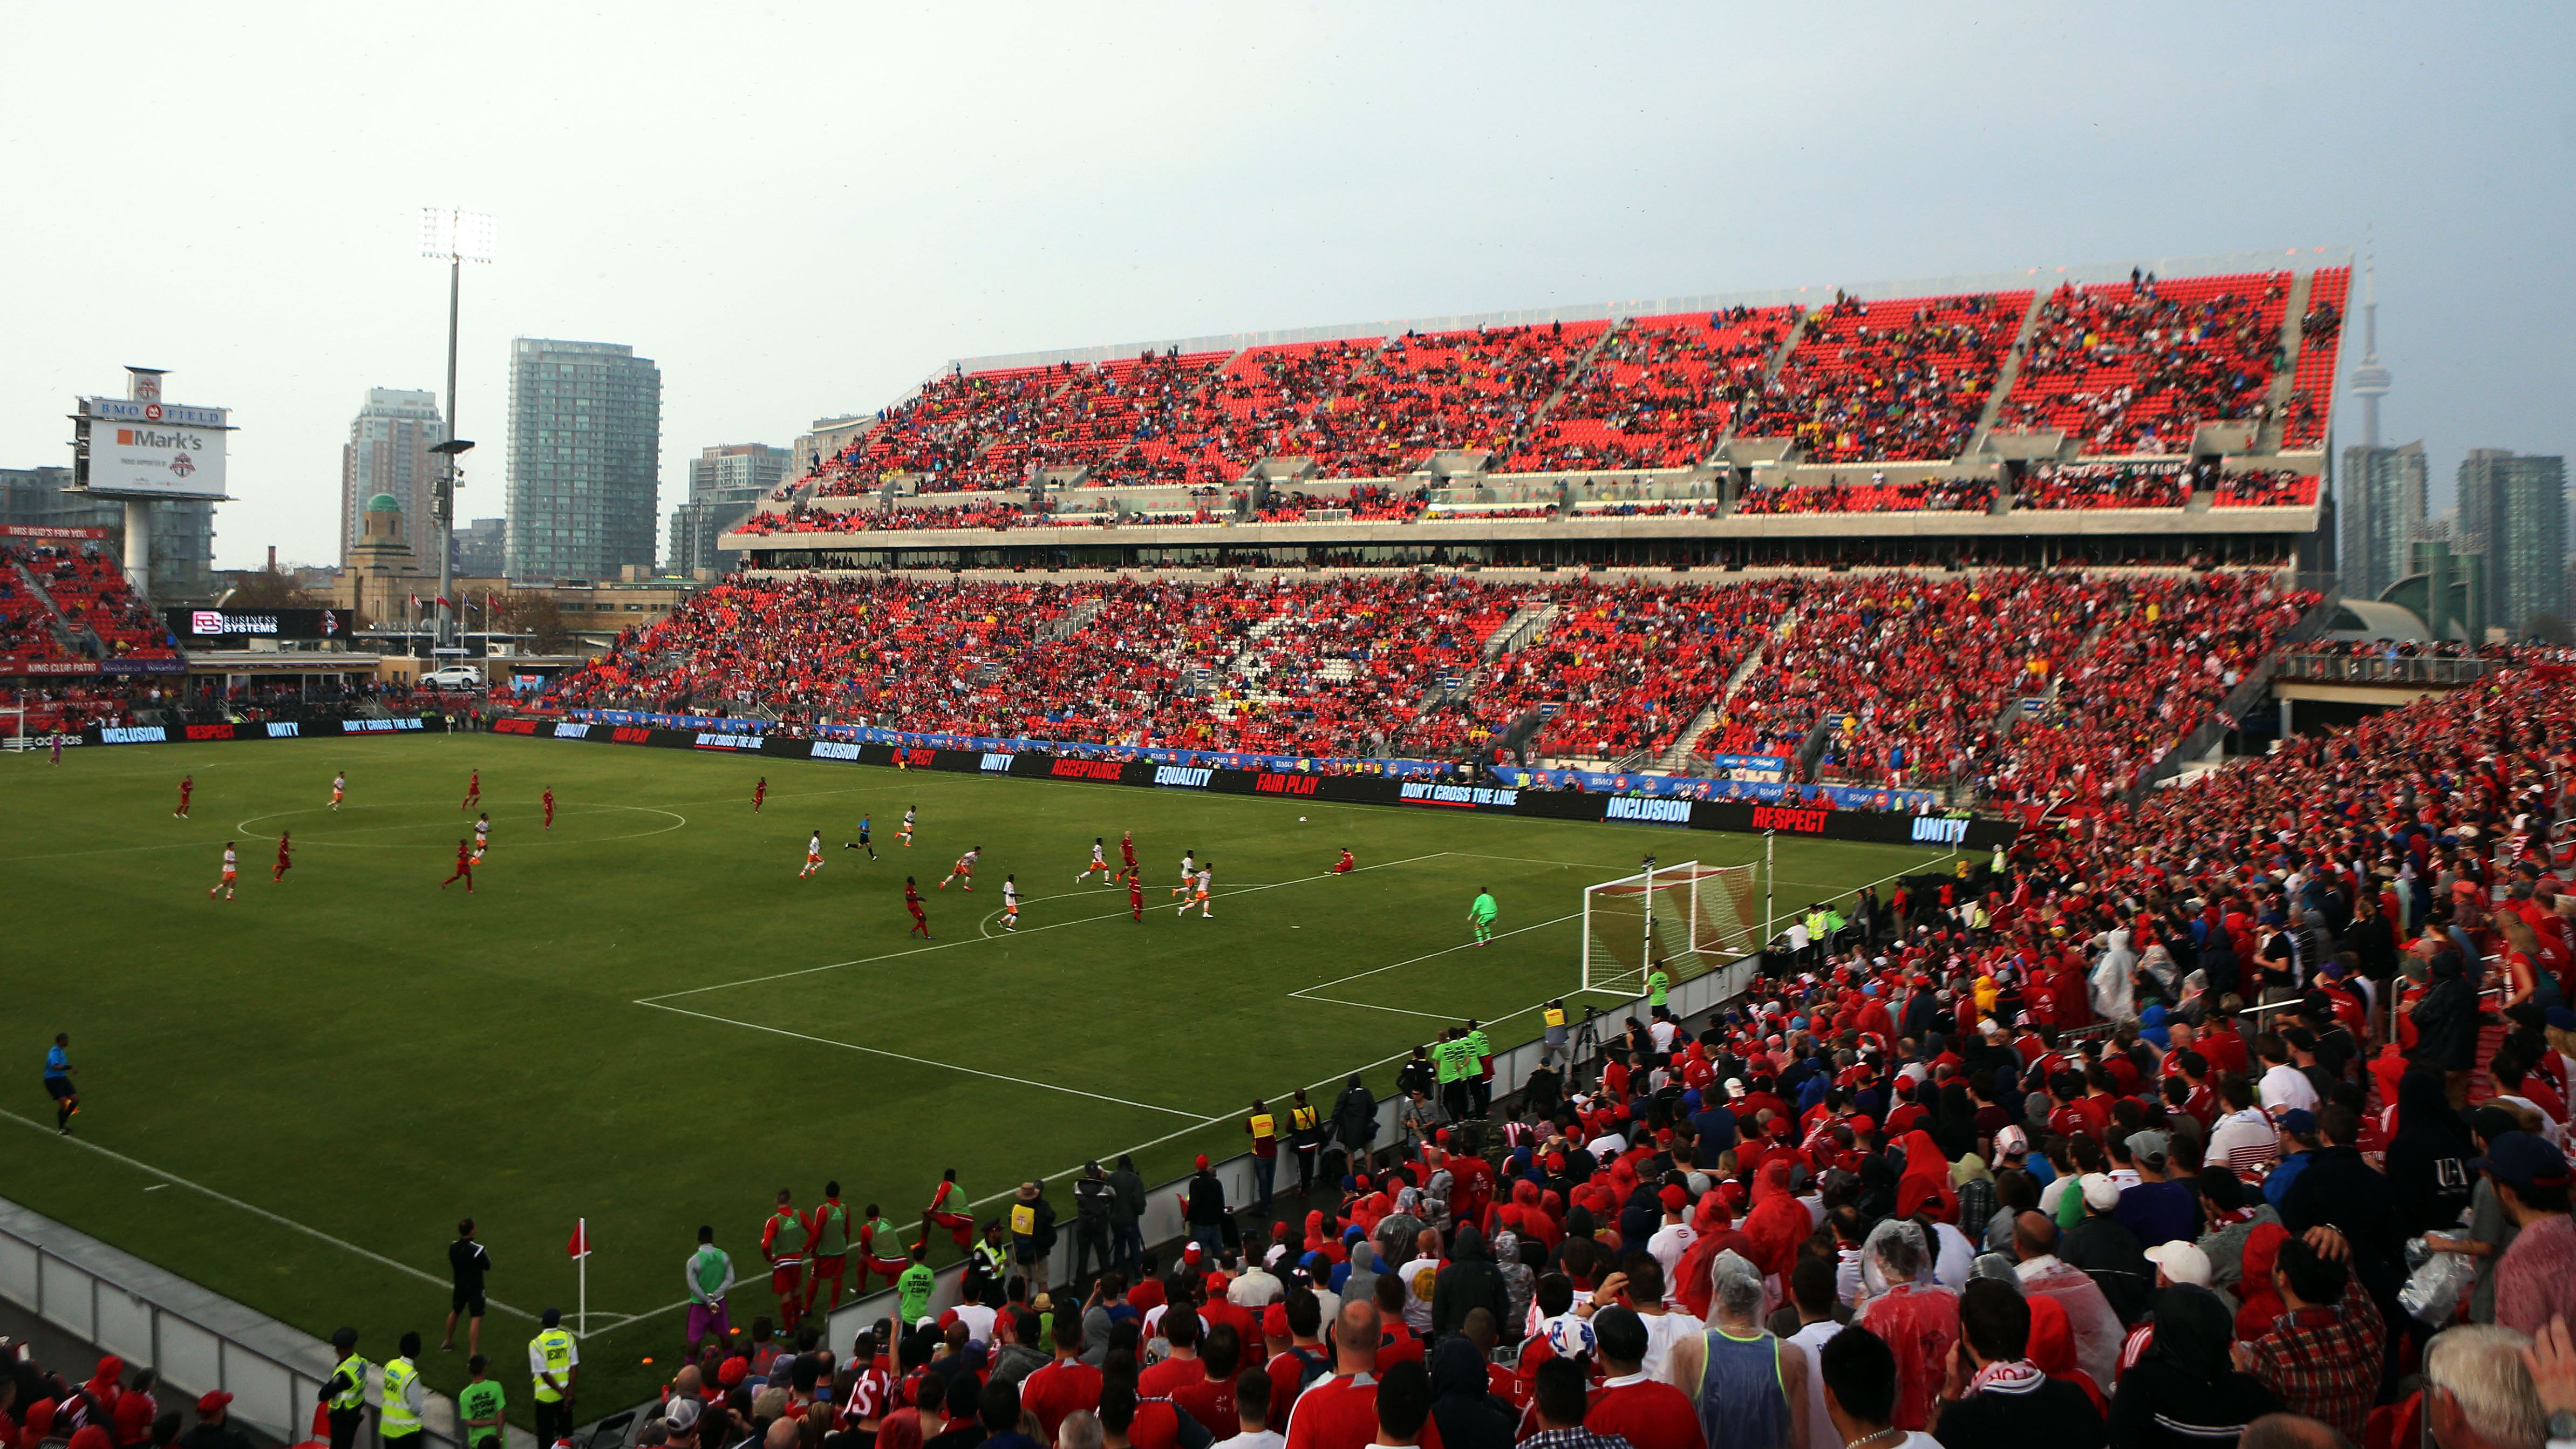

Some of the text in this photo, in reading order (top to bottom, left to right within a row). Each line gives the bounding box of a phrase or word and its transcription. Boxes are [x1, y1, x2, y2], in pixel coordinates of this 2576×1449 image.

[101, 403, 219, 423] BMO FIELD
[135, 430, 202, 451] Mark's
[9, 527, 28, 535] THIS
[54, 528, 70, 538] FOR
[224, 615, 278, 624] BUSINESS
[223, 624, 278, 634] SYSTEMS
[28, 663, 97, 672] KING CLUB PATIO
[186, 724, 235, 740] RESPECT
[266, 721, 299, 738] UNITY
[342, 717, 425, 732] DON'T CROSS THE LINE
[554, 723, 591, 738] EQUALITY
[35, 732, 83, 747] addas
[101, 726, 167, 744] INCLUSION
[611, 726, 652, 743] FAIR PLAY
[696, 733, 765, 749] DON'T CROSS THE LINE
[810, 740, 862, 760] INCLUSION
[979, 753, 1015, 772] UNITY
[1052, 758, 1125, 781] ACCEPTANCE
[1154, 765, 1214, 787] EQUALITY
[1256, 773, 1320, 795] FAIR PLAY
[1592, 778, 1613, 786] BMO
[1400, 783, 1519, 806] DON'T CROSS THE LINE
[1674, 783, 1695, 791] BMO
[1606, 797, 1693, 823] INCLUSION
[1752, 806, 1829, 833] RESPECT
[1911, 817, 1970, 843] UNITY
[851, 1379, 877, 1417] S
